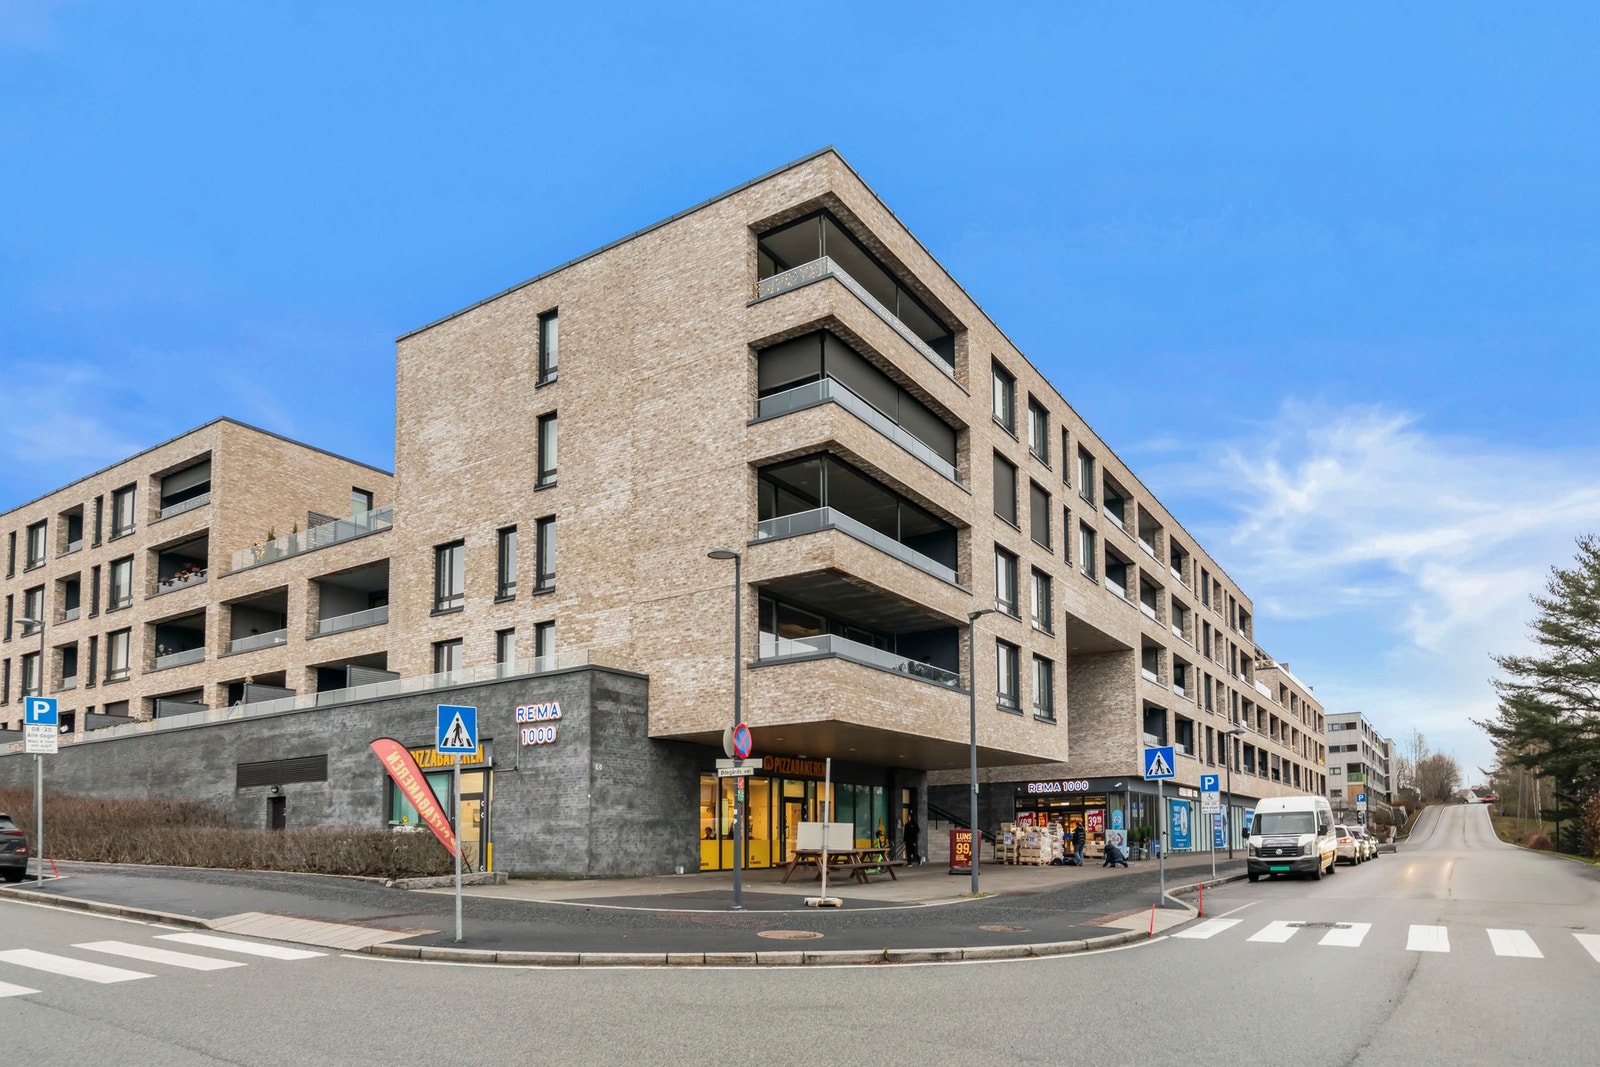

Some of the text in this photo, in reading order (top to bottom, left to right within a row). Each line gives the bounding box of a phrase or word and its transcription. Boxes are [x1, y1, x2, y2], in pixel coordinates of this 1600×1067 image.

[33, 700, 50, 721] P
[517, 703, 560, 721] REMA
[521, 727, 555, 744] 1000
[774, 757, 827, 777] PIZZABAKEREN
[1028, 780, 1089, 793] REMA 1000
[1204, 777, 1215, 790] P
[1358, 794, 1364, 802] P
[1088, 816, 1096, 827] 39
